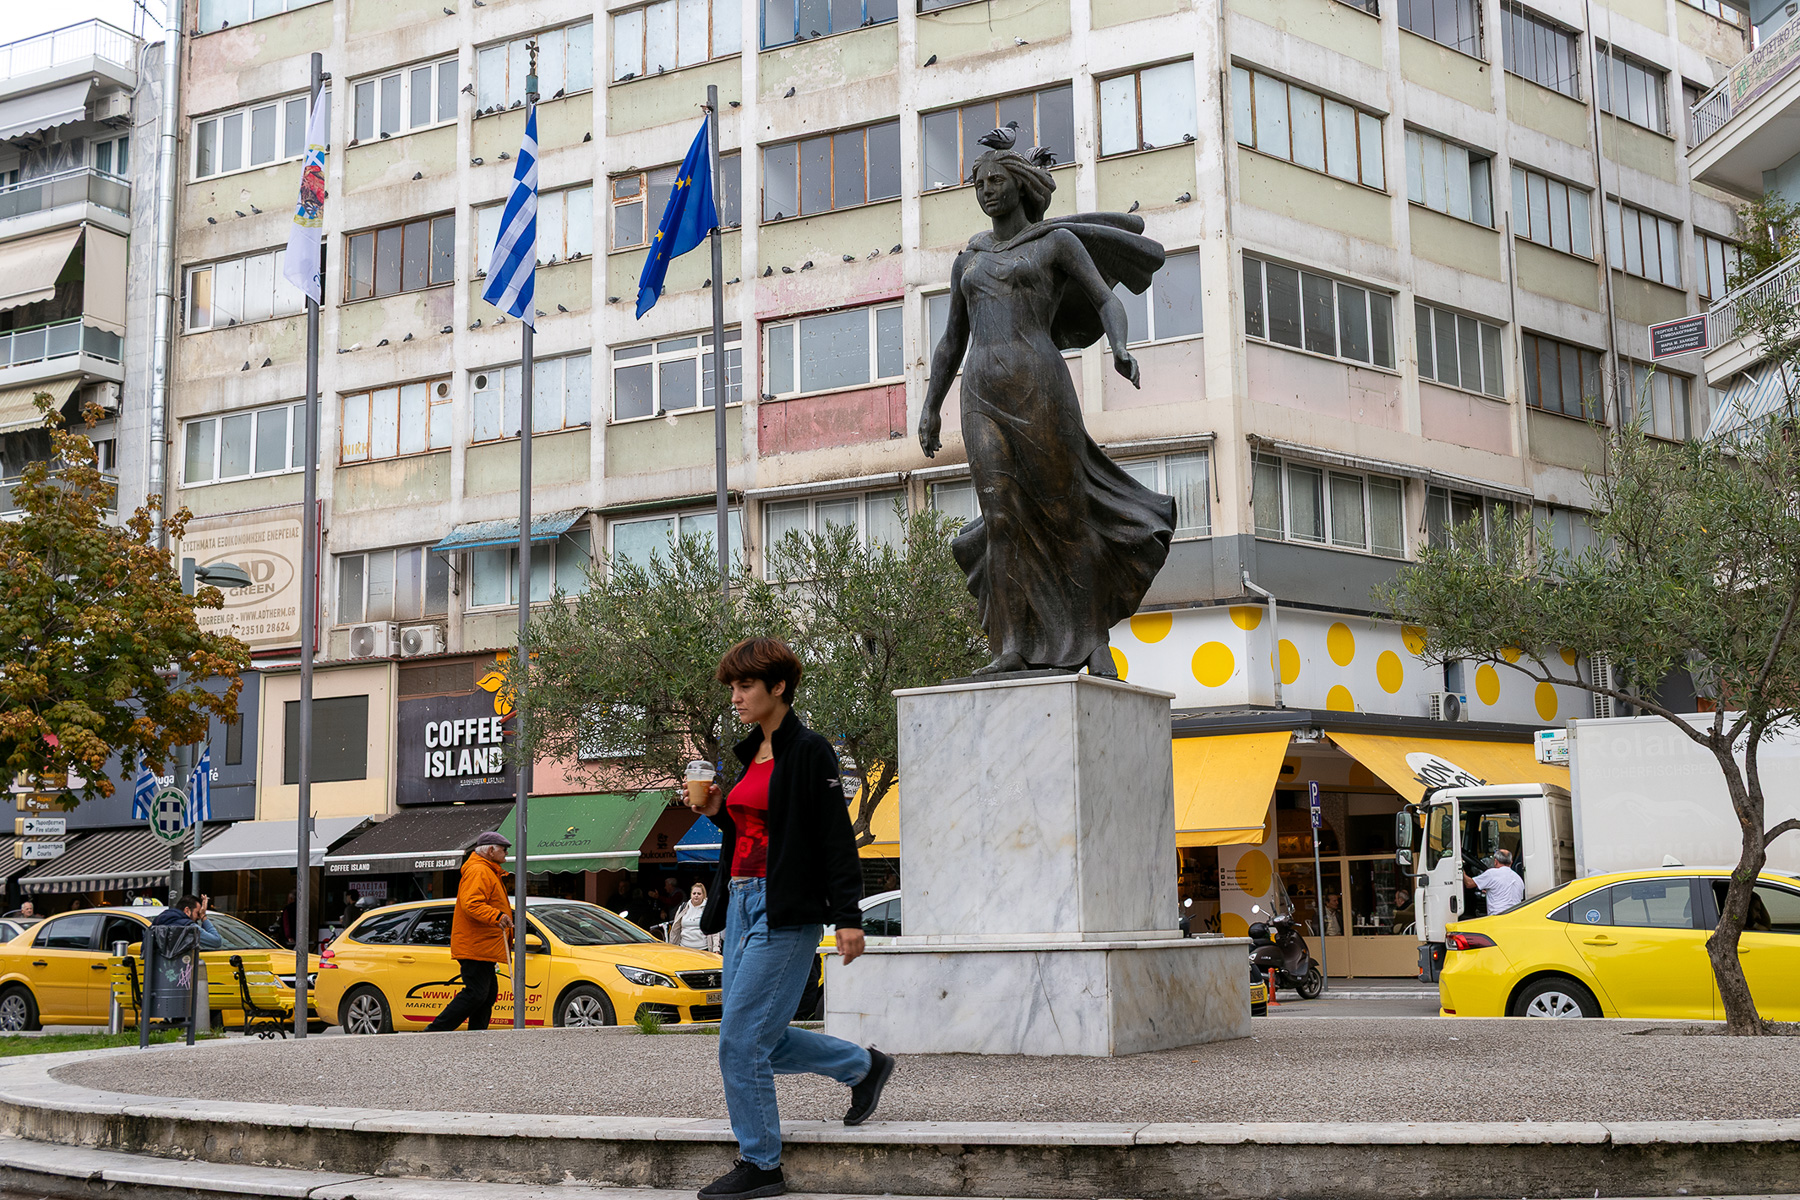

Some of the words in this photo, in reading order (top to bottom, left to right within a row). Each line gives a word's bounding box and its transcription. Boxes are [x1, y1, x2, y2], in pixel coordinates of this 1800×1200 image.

[182, 537, 216, 553] ΣΥΣΤΗΜΑΤΑ
[229, 583, 275, 597] GREEN
[241, 624, 265, 636] 23510
[266, 621, 291, 633] 28624
[425, 716, 503, 748] COFFEE
[1583, 729, 1706, 758] Rolan
[424, 746, 503, 778] ISLAND
[36, 802, 50, 810] Park
[330, 864, 350, 872] COFFEE
[350, 863, 370, 872] ISLAND
[414, 860, 434, 869] COFFEE
[435, 858, 456, 868] ISLAND
